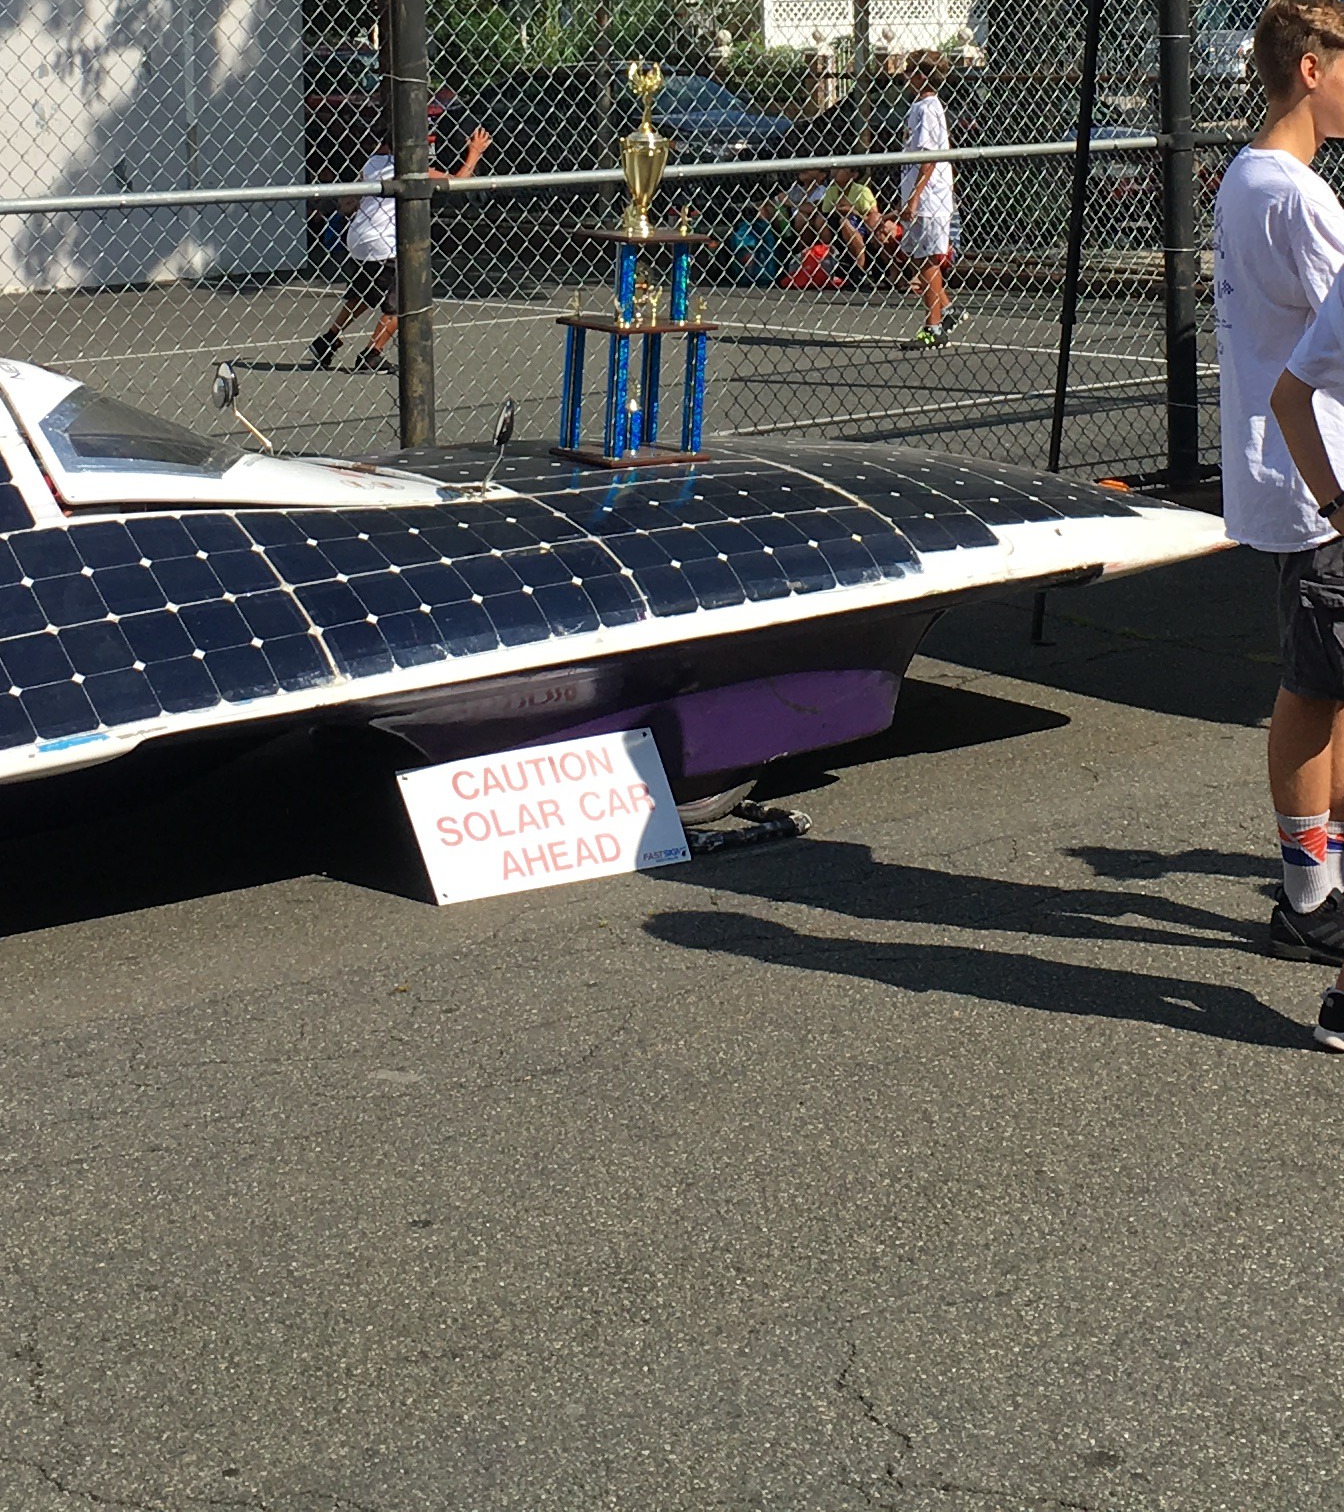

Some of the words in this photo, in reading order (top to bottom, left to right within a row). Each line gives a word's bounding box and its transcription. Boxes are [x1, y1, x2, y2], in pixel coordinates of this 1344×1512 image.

[451, 747, 614, 801] CAUTION
[436, 799, 565, 847] SOLAR
[578, 782, 656, 822] CAR
[502, 833, 621, 881] AHEAD
